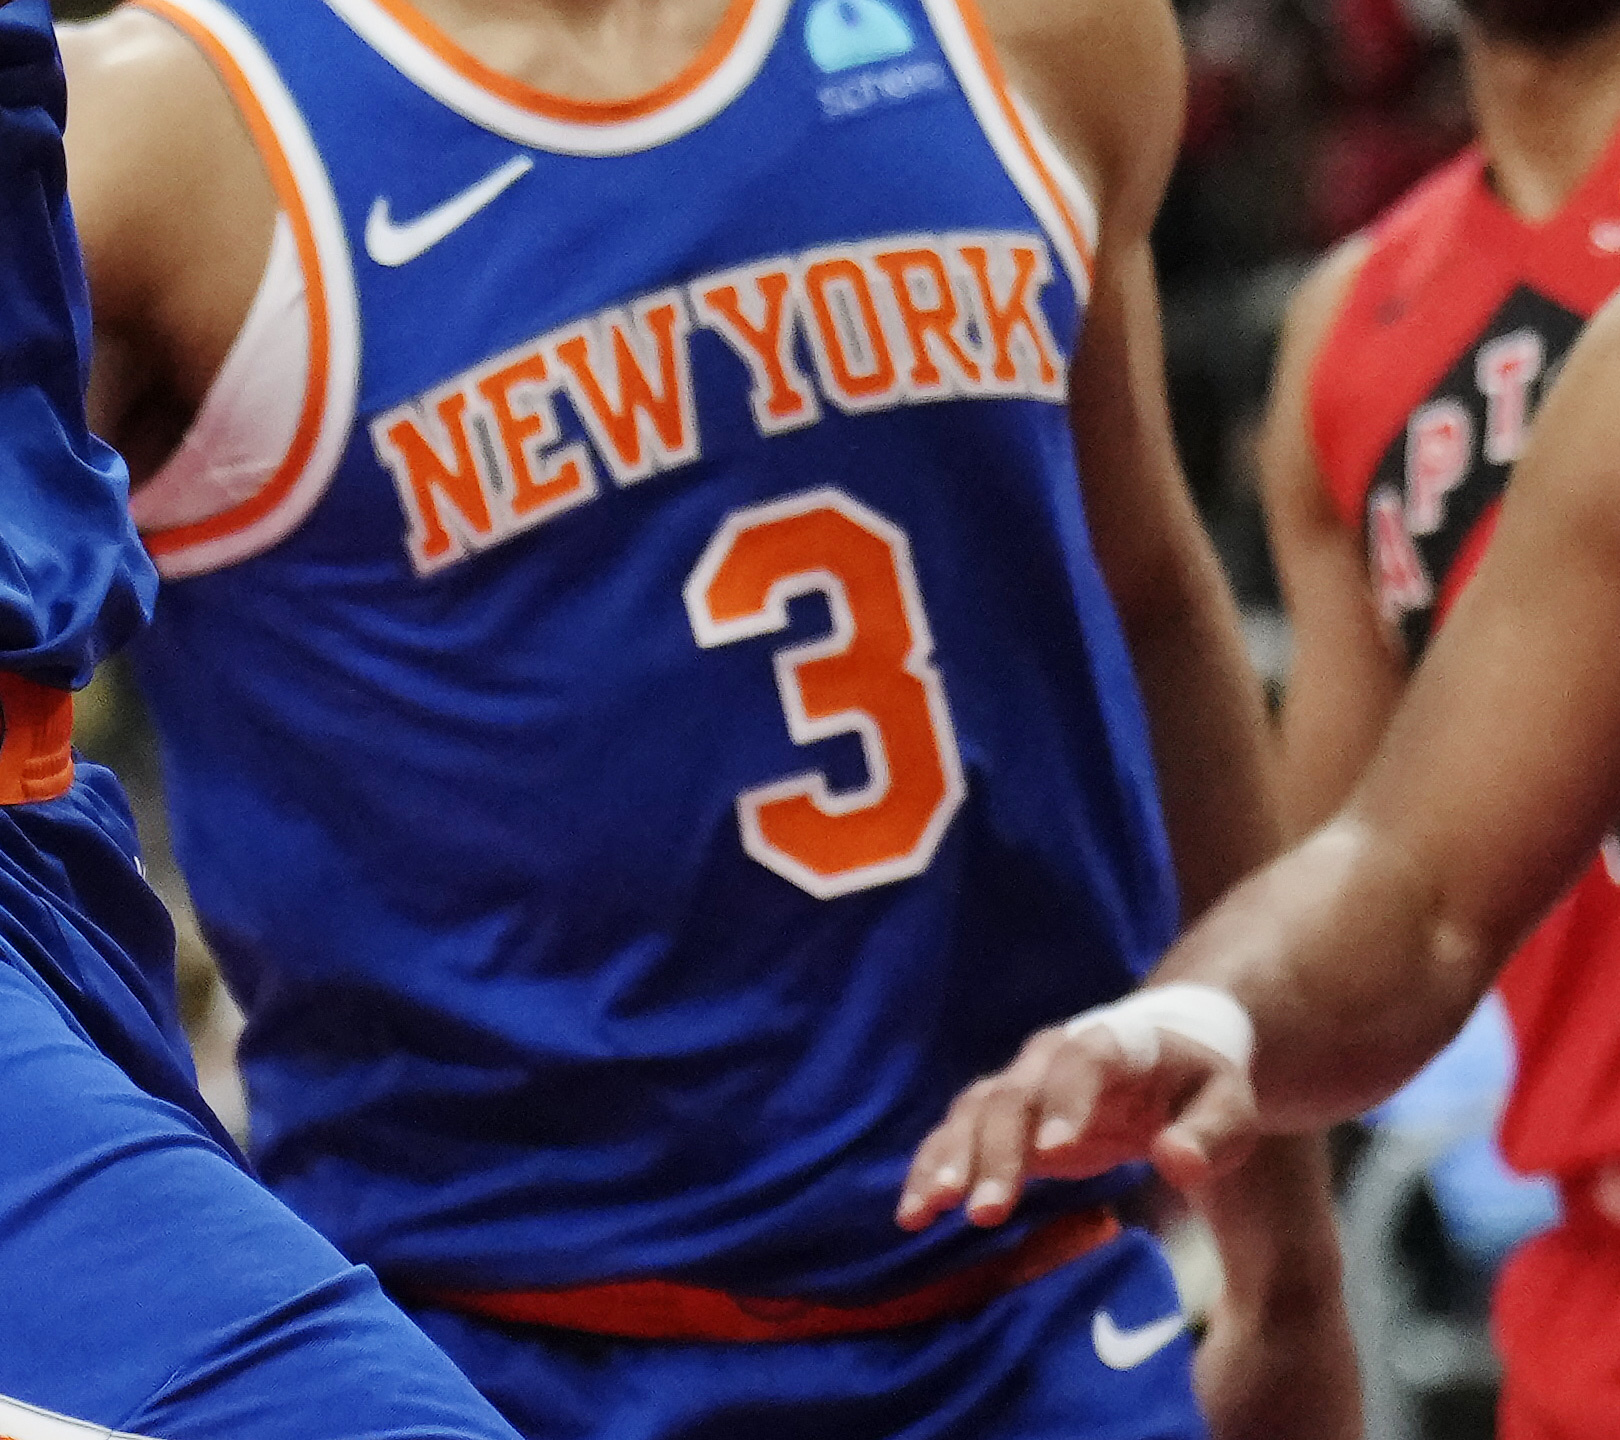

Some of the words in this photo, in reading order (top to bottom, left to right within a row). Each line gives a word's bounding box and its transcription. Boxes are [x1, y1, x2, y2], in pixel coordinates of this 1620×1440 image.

[371, 289, 700, 576] NEW
[686, 229, 1068, 437] YORK
[682, 485, 965, 900] 3
